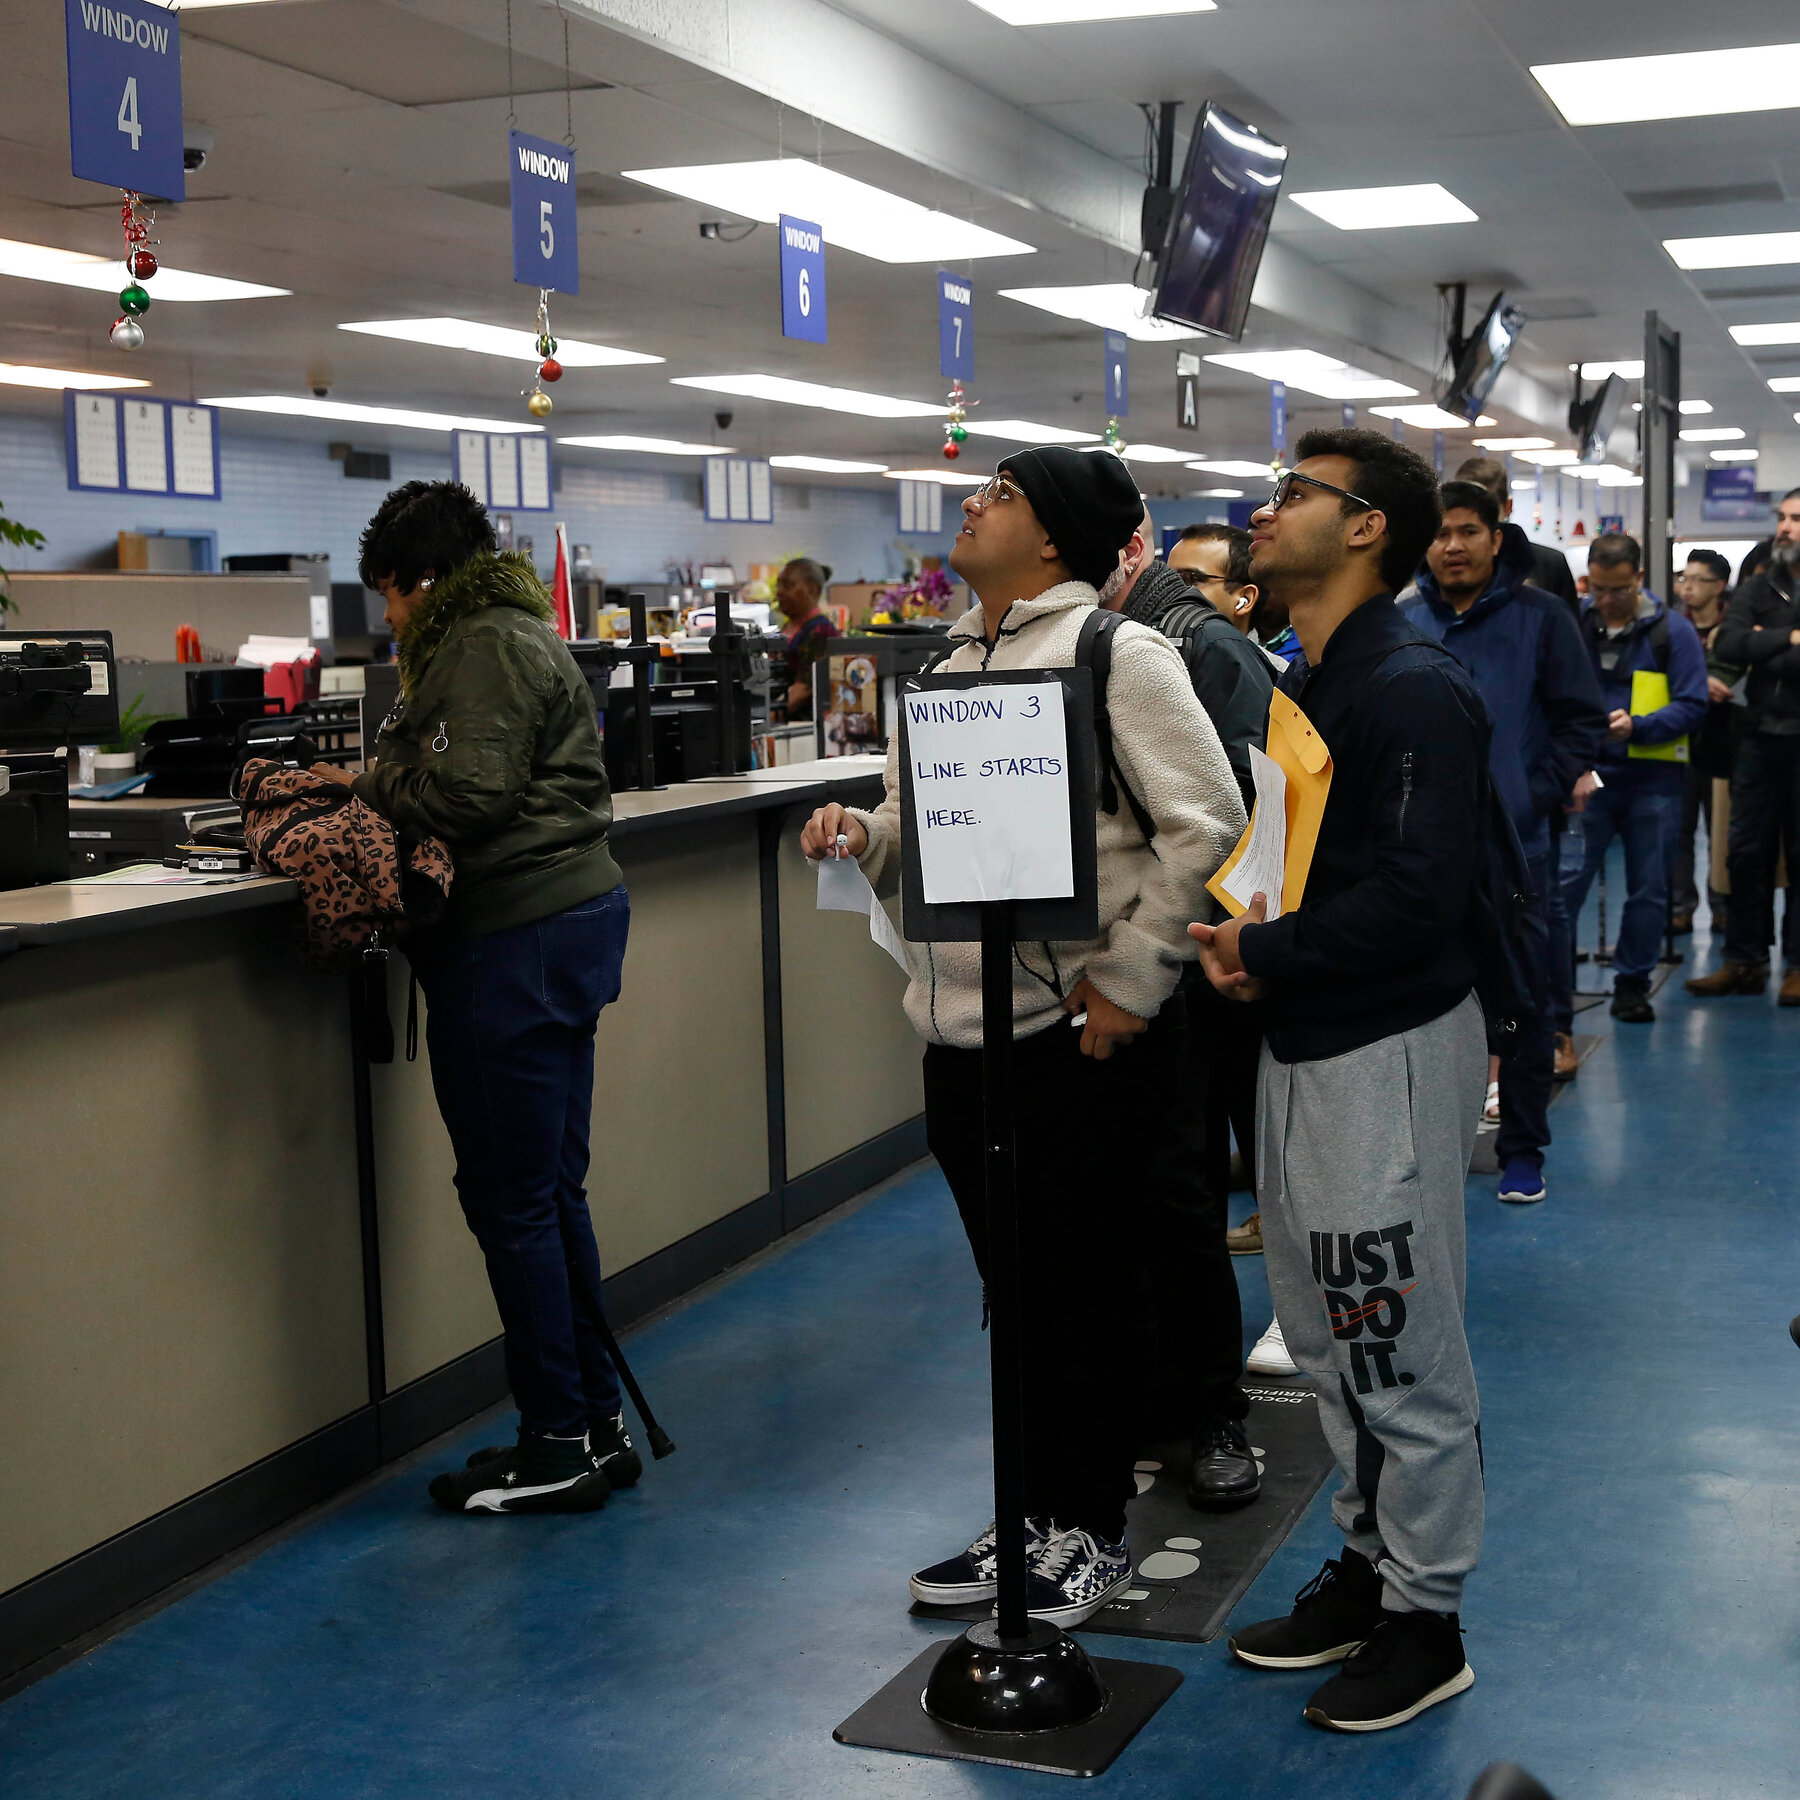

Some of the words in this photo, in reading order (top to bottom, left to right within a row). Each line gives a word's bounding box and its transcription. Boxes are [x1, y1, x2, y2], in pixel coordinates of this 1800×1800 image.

[80, 0, 168, 54] WINDOW
[117, 76, 142, 151] 4
[518, 147, 570, 184] WINDOW
[540, 200, 554, 259] 5
[785, 226, 820, 254] WINDOW
[799, 268, 810, 317] 6
[944, 282, 971, 306] WINDOW
[953, 317, 962, 358] 7
[1183, 380, 1196, 426] A
[909, 699, 1003, 724] WINDOW
[1019, 696, 1041, 718] 3
[917, 761, 967, 780] LINE
[979, 757, 1062, 777] STARTS
[926, 809, 982, 829] HERE.
[1309, 1219, 1415, 1289] JUST
[1323, 1286, 1407, 1340] DO
[1349, 1339, 1416, 1395] IT.
[1248, 1395, 1303, 1404] DOCU
